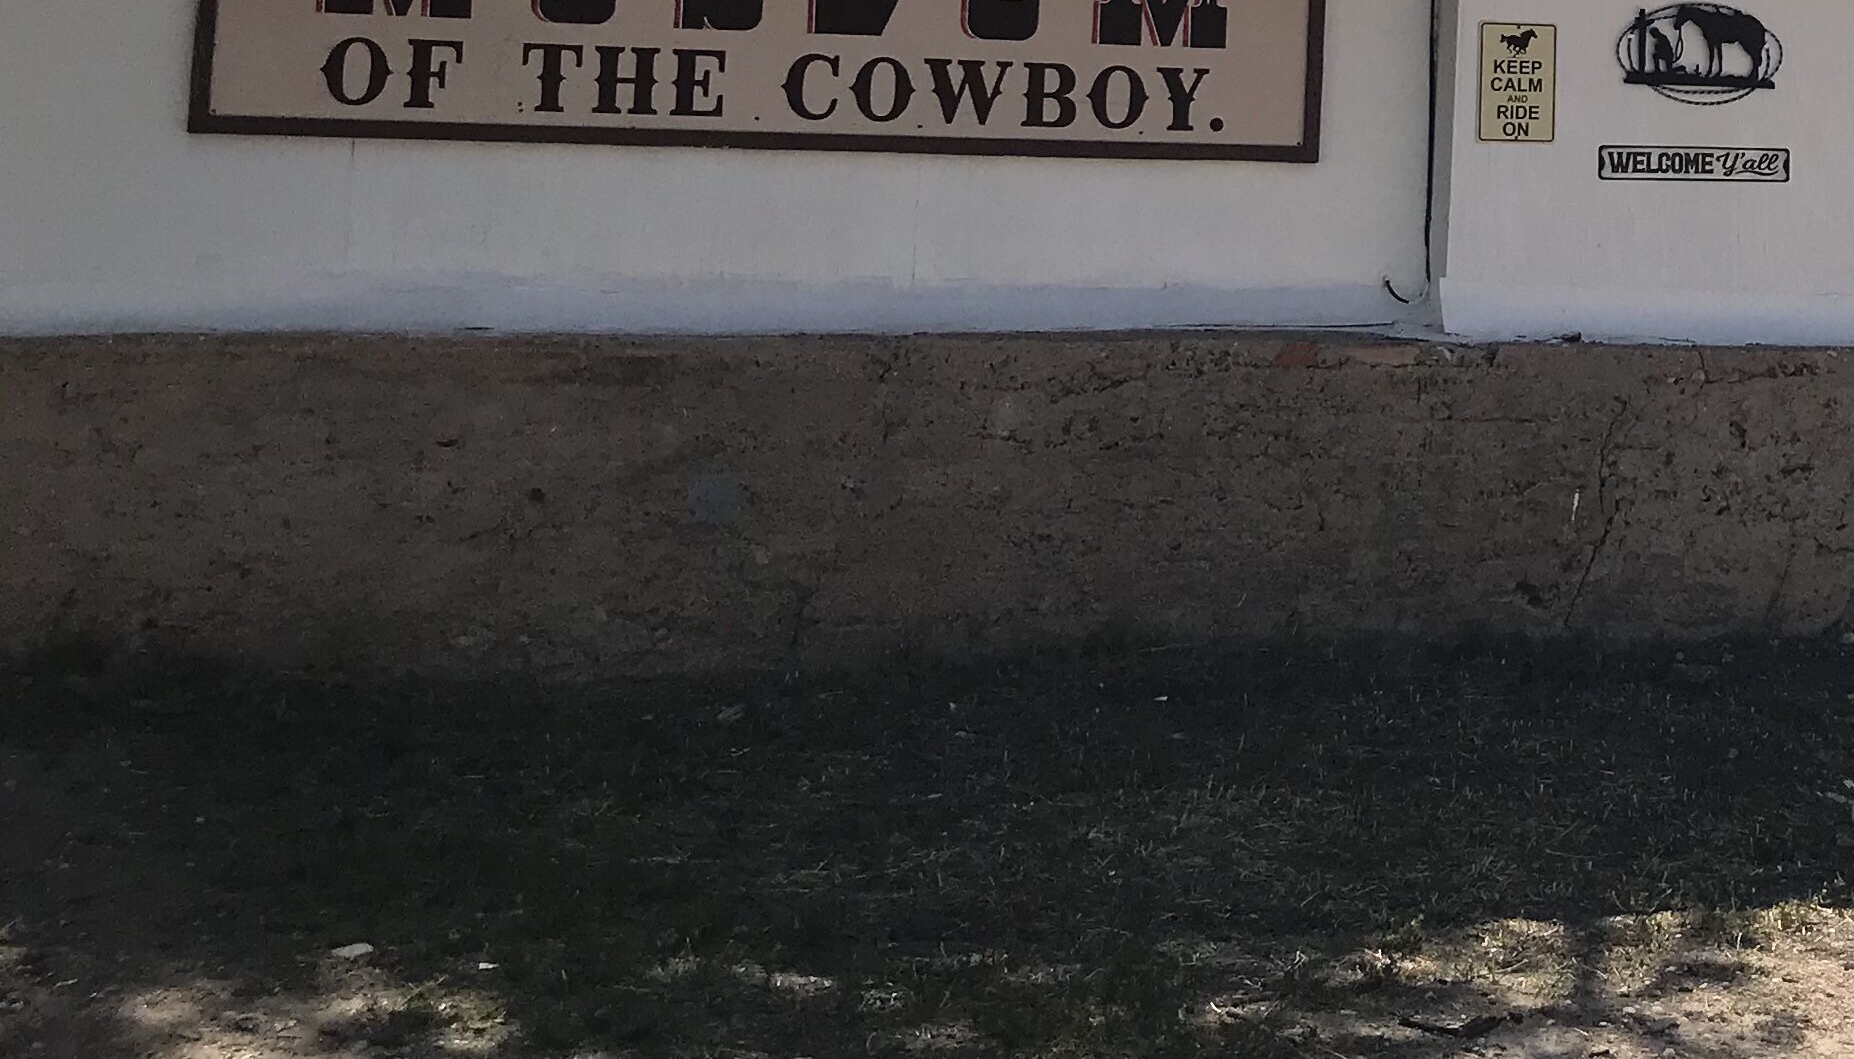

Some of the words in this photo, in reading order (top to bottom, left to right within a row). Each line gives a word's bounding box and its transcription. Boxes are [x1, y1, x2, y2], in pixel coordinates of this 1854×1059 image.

[1493, 60, 1543, 75] KEEP
[319, 36, 465, 110] OF
[522, 43, 727, 117] THE
[780, 54, 1226, 133] COWBOY.
[1490, 77, 1543, 93] CALM
[1507, 95, 1528, 103] AND
[1497, 106, 1540, 120] RIDE
[1502, 122, 1529, 137] ON
[1607, 151, 1714, 174] WELCOME
[1715, 153, 1779, 176] Y'all
